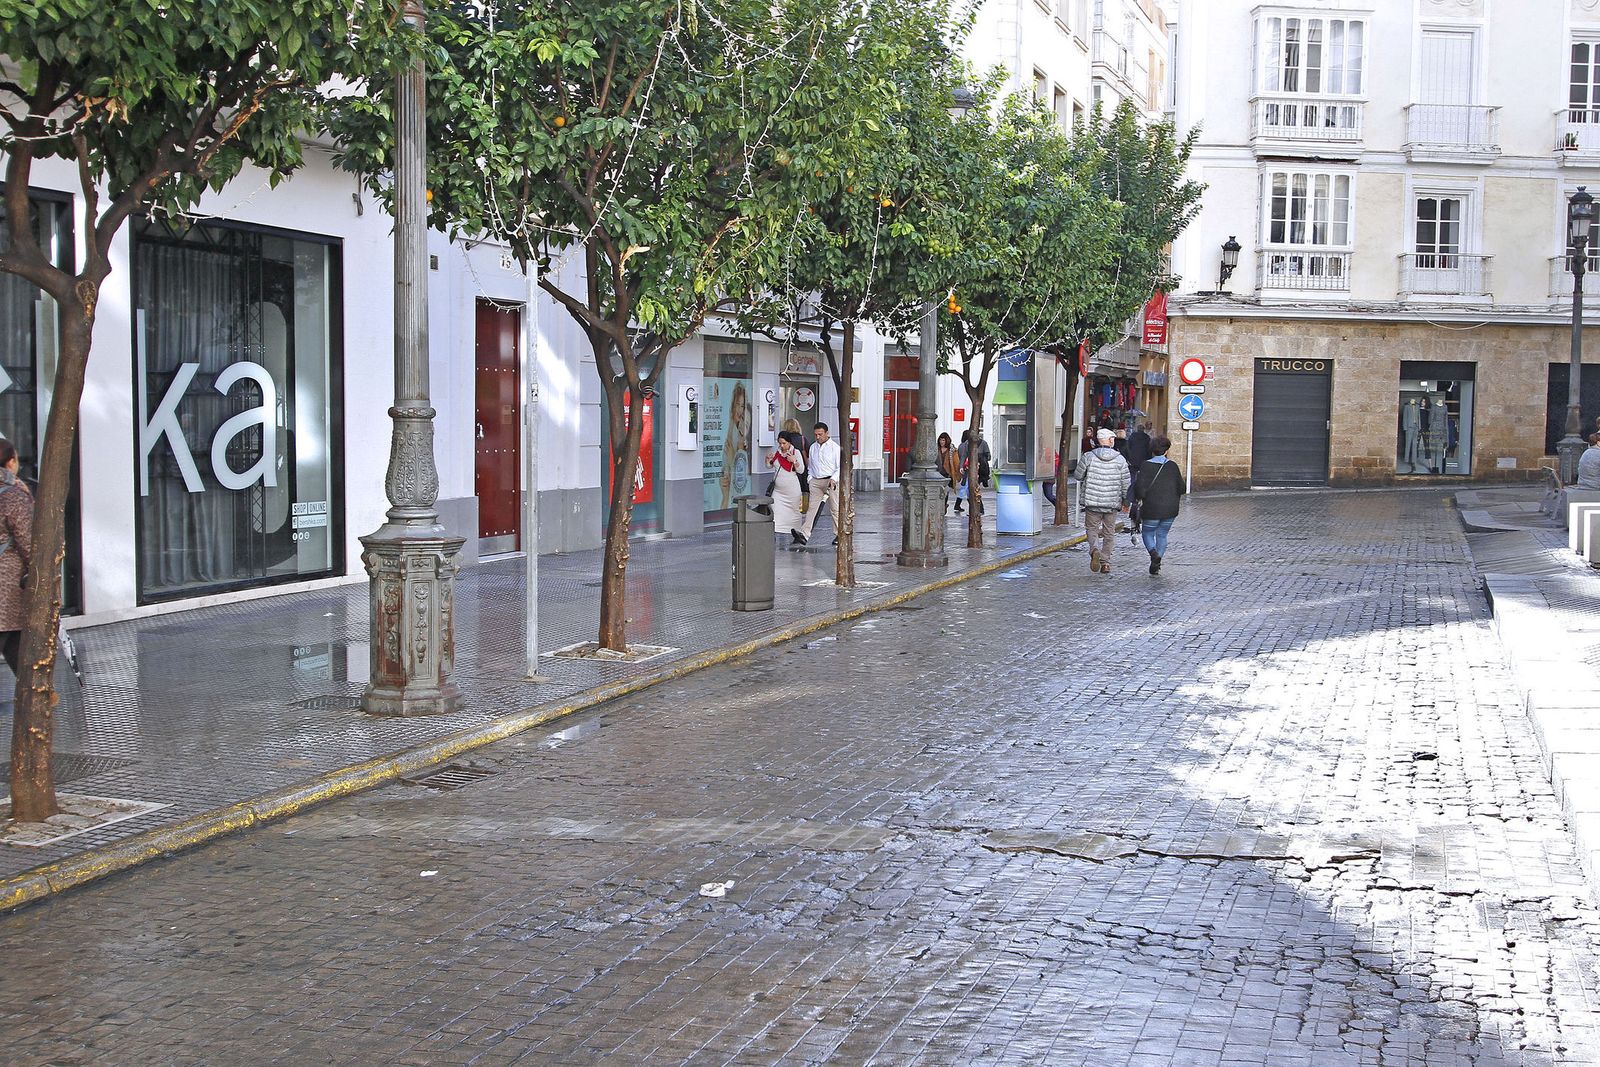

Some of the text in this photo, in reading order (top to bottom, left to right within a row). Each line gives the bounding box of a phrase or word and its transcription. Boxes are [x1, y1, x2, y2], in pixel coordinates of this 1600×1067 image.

[1261, 360, 1325, 371] TRUCCO
[294, 502, 325, 514] SHOP ONLINE
